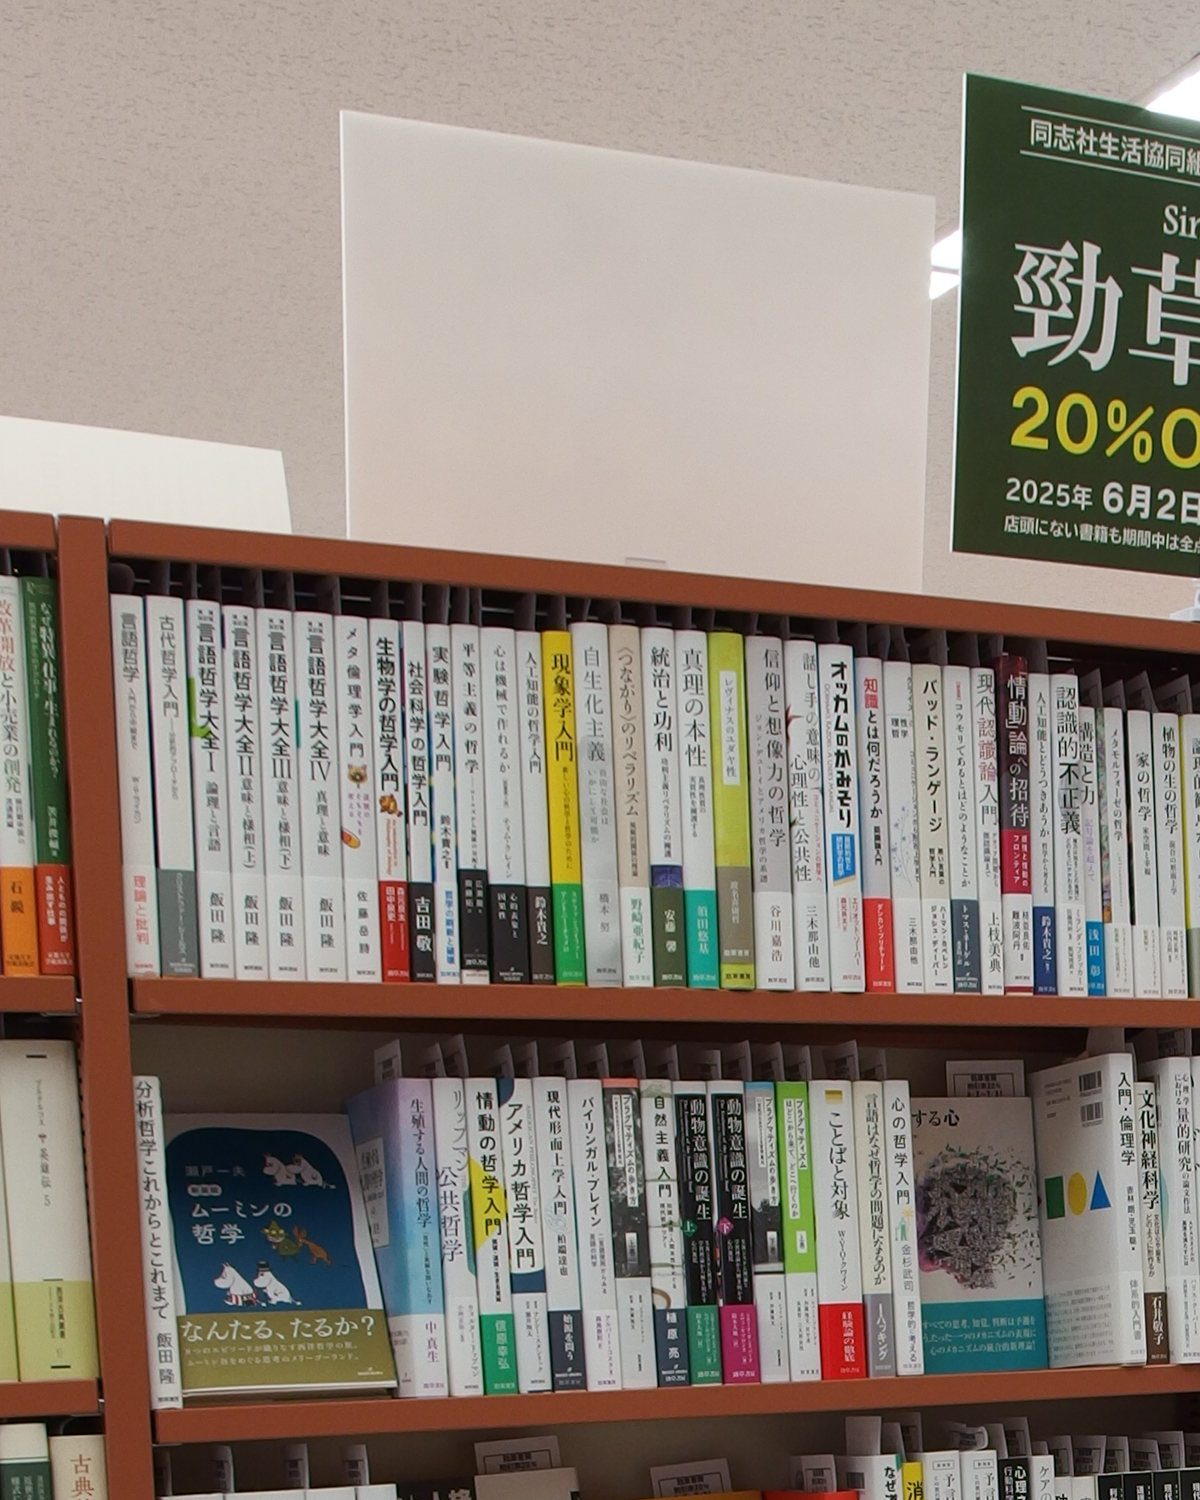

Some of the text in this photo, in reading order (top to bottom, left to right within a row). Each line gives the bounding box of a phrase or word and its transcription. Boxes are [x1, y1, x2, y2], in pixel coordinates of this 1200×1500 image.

[1006, 478, 1093, 511] 2025年
[120, 612, 139, 682] 言語哲学
[159, 615, 179, 717] 古代哲学入門
[347, 628, 364, 758] メタ倫理学入門
[583, 646, 605, 762] 自生化主義
[651, 646, 672, 752] 統治と功利
[376, 636, 399, 793] 生物学の哲学入門
[408, 662, 428, 826] 社会科学の哲学入門
[432, 646, 452, 772] 実験哲学入門
[493, 645, 511, 773] 心は機械で作れるか
[525, 652, 541, 774] 人工知能の哲学入門
[551, 654, 574, 762] 現象学入門
[682, 649, 707, 768] 真理の本性
[763, 649, 786, 848] 信仰と想像力の哲学
[830, 662, 852, 828] オッカムのかみそり
[864, 678, 884, 819] 知識とは何だろうか
[923, 680, 943, 831] バッド・ランゲージ
[977, 674, 1000, 826] 現代認識論入門
[1056, 686, 1082, 835] 認識的不正義
[206, 781, 221, 852] 論理と言語
[790, 754, 812, 882] 心理性と公共性
[1136, 751, 1152, 822] 家の哲学
[1162, 727, 1178, 835] 植物の生の哲学
[133, 875, 149, 945] 理論と批判
[770, 905, 783, 962] 谷川嘉浩
[806, 906, 820, 968] 三木那由他
[410, 1098, 432, 1229] 生殖する人間の哲学
[476, 1092, 502, 1236] 情動の哲学入門
[547, 1091, 567, 1215] 現代形而上学入門
[582, 1097, 602, 1227] バイリンガル・ブレイン
[654, 1096, 672, 1198] 自然主義入門
[690, 1099, 712, 1220] 動物意識の誕生
[827, 1111, 850, 1220] ことばと対象
[891, 1097, 910, 1204] 心の哲学入門
[1118, 1072, 1135, 1166] 入門・倫理学
[1137, 1090, 1159, 1210] 文化神経科学
[135, 1081, 168, 1320] 分析哲学これからとこれまで
[191, 1202, 293, 1218] ムーミンの
[192, 1223, 245, 1244] 哲学
[439, 1167, 464, 1262] 公共哲学
[506, 1103, 536, 1269] アメリカ哲学入門
[866, 1093, 886, 1286] 言語はなぜ哲学の問題になるのか
[181, 1316, 375, 1343] なんたる、たるか?
[1150, 1296, 1164, 1345] 石井敬子
